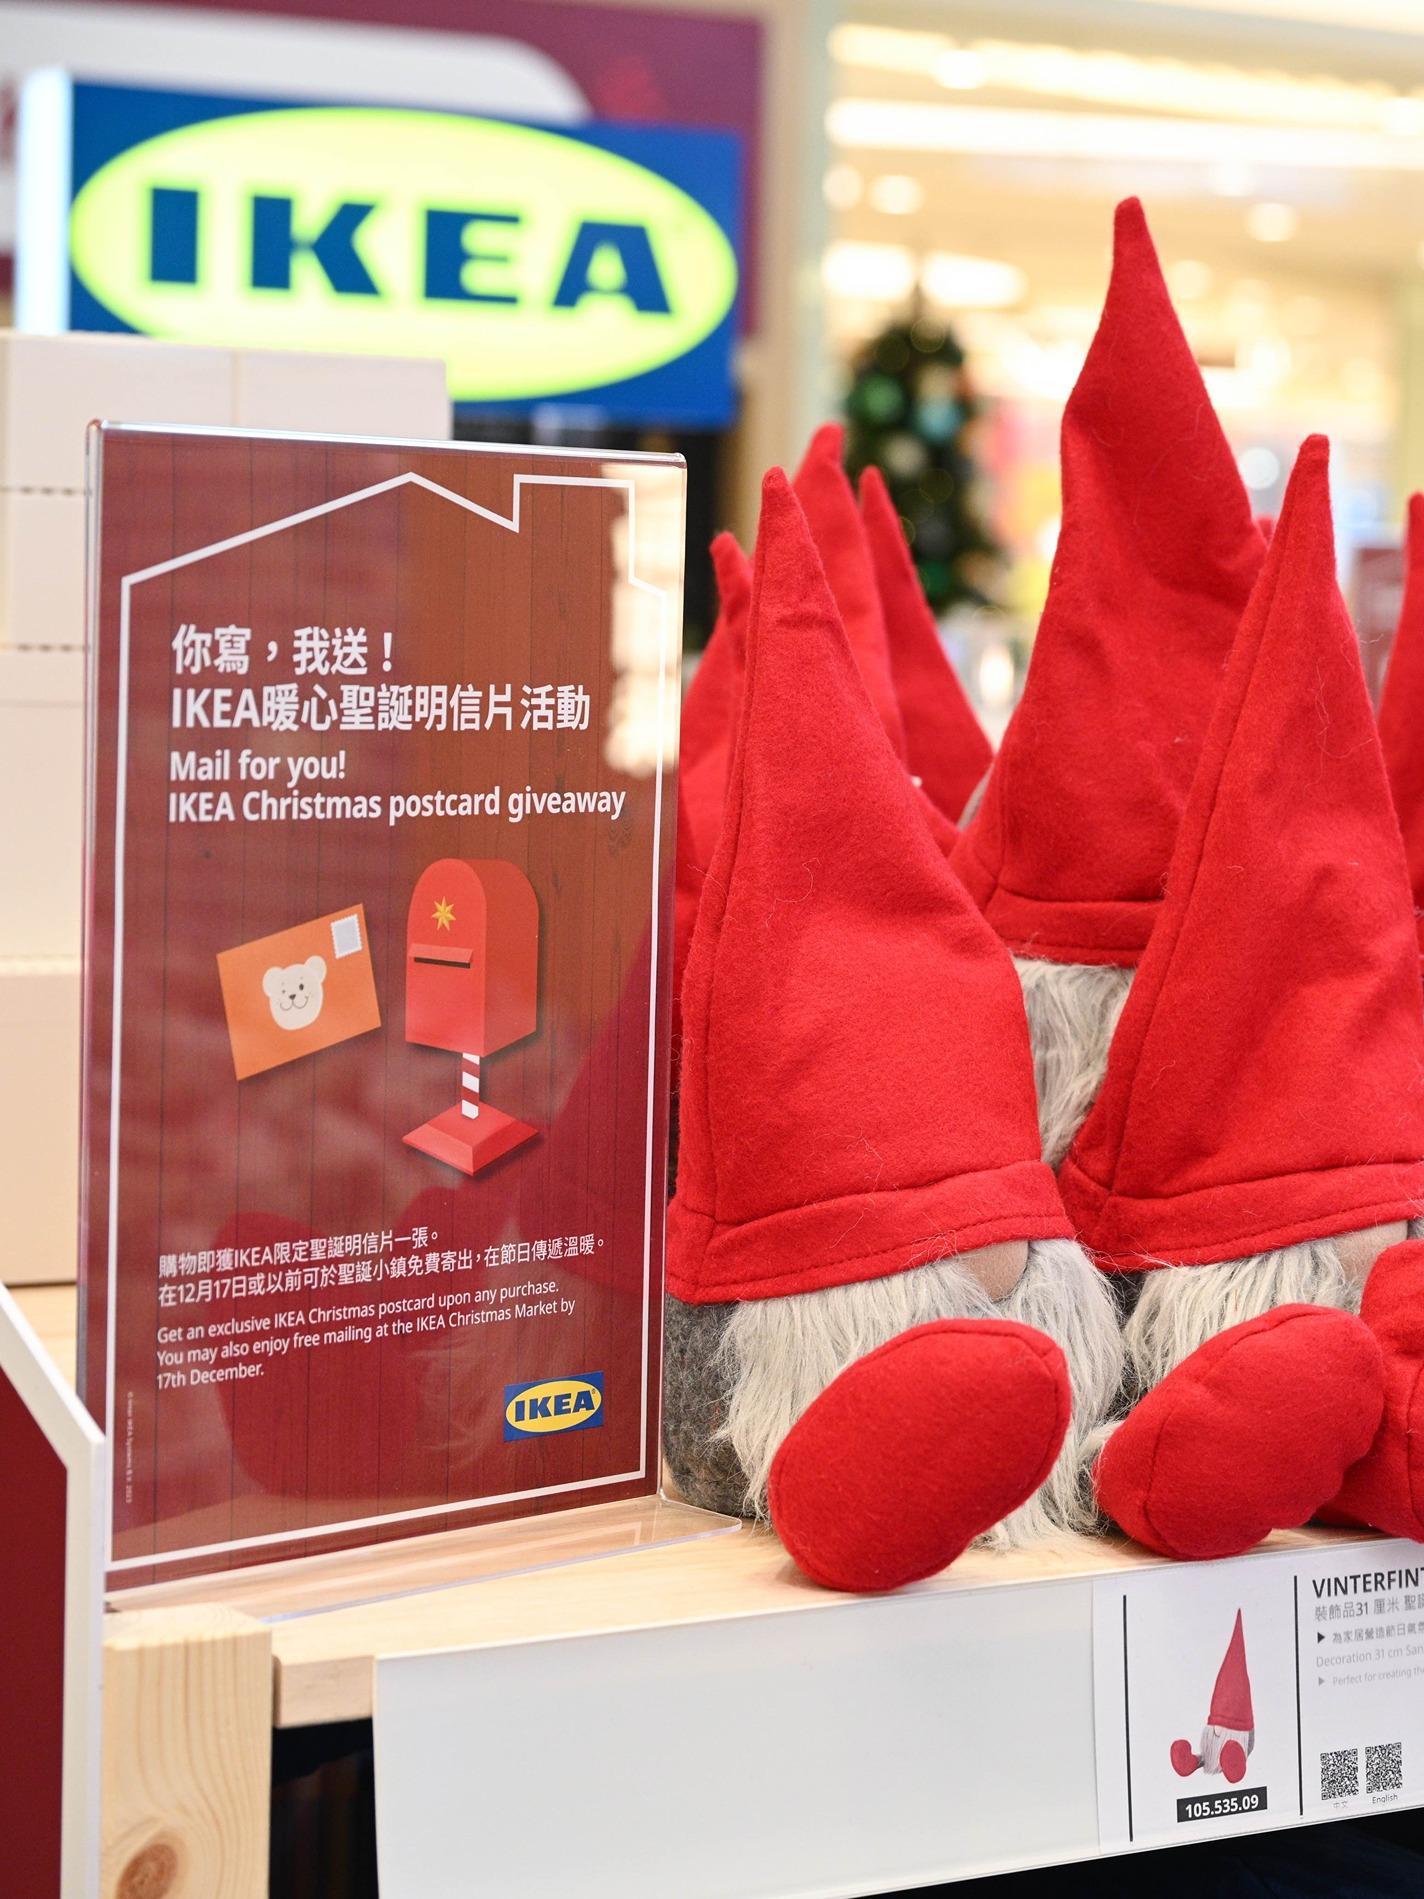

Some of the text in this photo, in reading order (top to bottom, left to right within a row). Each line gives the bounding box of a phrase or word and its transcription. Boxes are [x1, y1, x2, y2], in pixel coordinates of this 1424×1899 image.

[148, 187, 673, 315] IKEA
[171, 624, 393, 675] 你寫，我送！
[172, 682, 590, 732] IKEA暖心聖誕明信片活動
[170, 749, 346, 788] Mail for you!
[169, 785, 626, 826] IKEA Christmas postcard giveaway
[157, 1297, 575, 1366] You may also enjoy free mailing at the IKEA Christmas Market by
[158, 1280, 559, 1344] Get an exclusive IKEA Christmas postcard upon any purchase.
[157, 1362, 264, 1389] 17th December.
[515, 1390, 595, 1423] IKEA
[1373, 1599, 1400, 1615] 厘米
[1316, 1651, 1372, 1669] Decoration
[1376, 1649, 1386, 1660] 31
[1388, 1648, 1404, 1658] cm
[1185, 1793, 1259, 1820] 105.535.09
[1372, 1794, 1398, 1806] English
